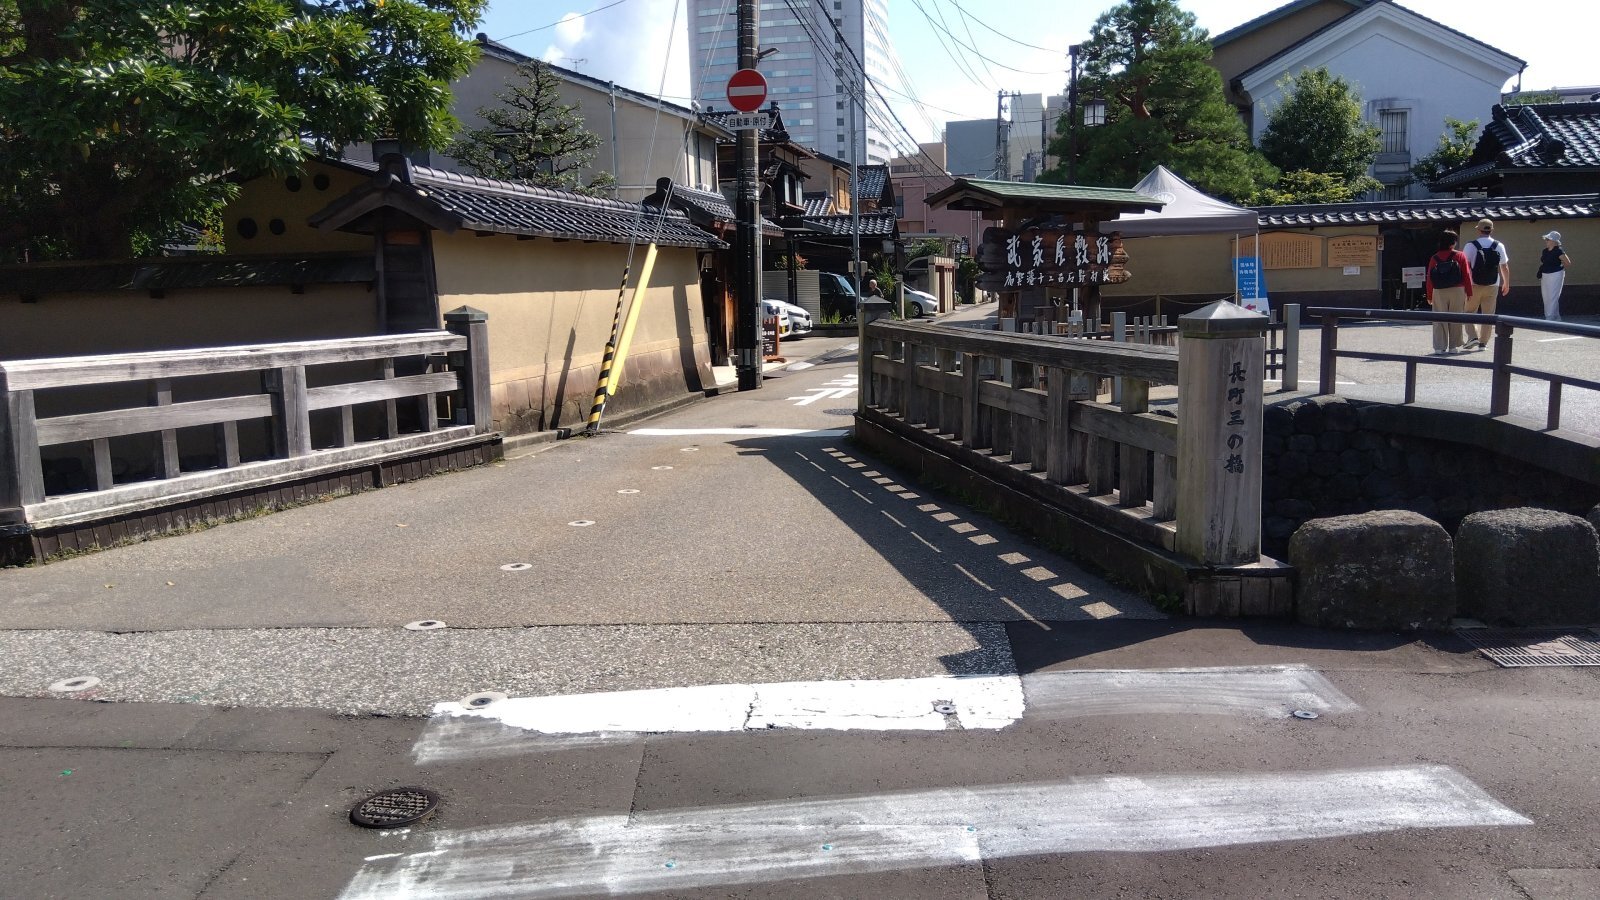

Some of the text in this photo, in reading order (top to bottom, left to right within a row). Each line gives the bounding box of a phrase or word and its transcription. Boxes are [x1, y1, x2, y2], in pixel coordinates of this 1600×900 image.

[1006, 234, 1111, 268] 武家屋敷跡
[1224, 361, 1246, 473] 長町三の橋
